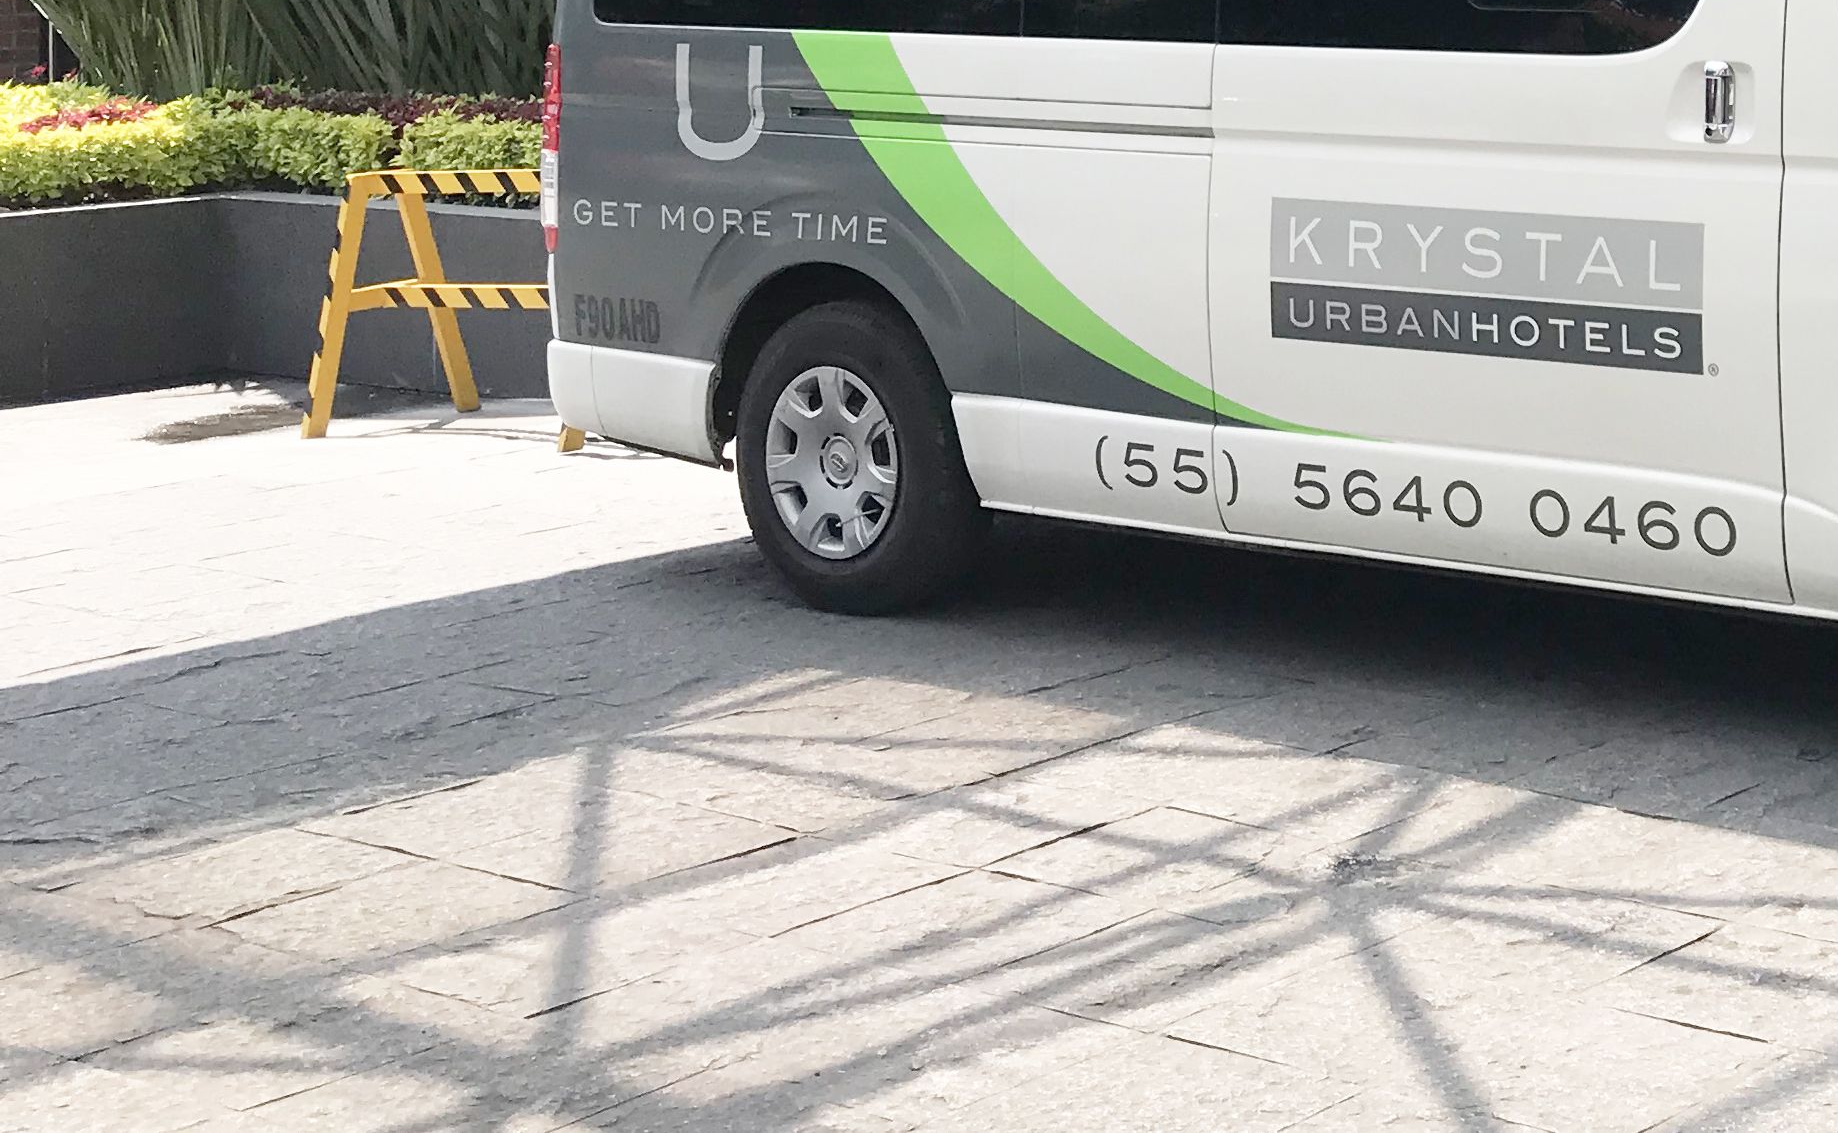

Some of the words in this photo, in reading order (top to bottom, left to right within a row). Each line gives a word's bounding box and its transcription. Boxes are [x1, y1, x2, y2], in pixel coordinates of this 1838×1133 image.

[675, 43, 765, 161] U
[573, 199, 642, 228] GET
[661, 205, 772, 238] MORE
[791, 212, 888, 245] TIME
[1288, 216, 1682, 291] KRYSTAL
[573, 294, 661, 344] F90AHD
[1289, 297, 1682, 359] URBANHOTELS
[1095, 435, 1239, 506] (55)
[1293, 462, 1483, 529] 5640
[1529, 488, 1737, 557] 0460
